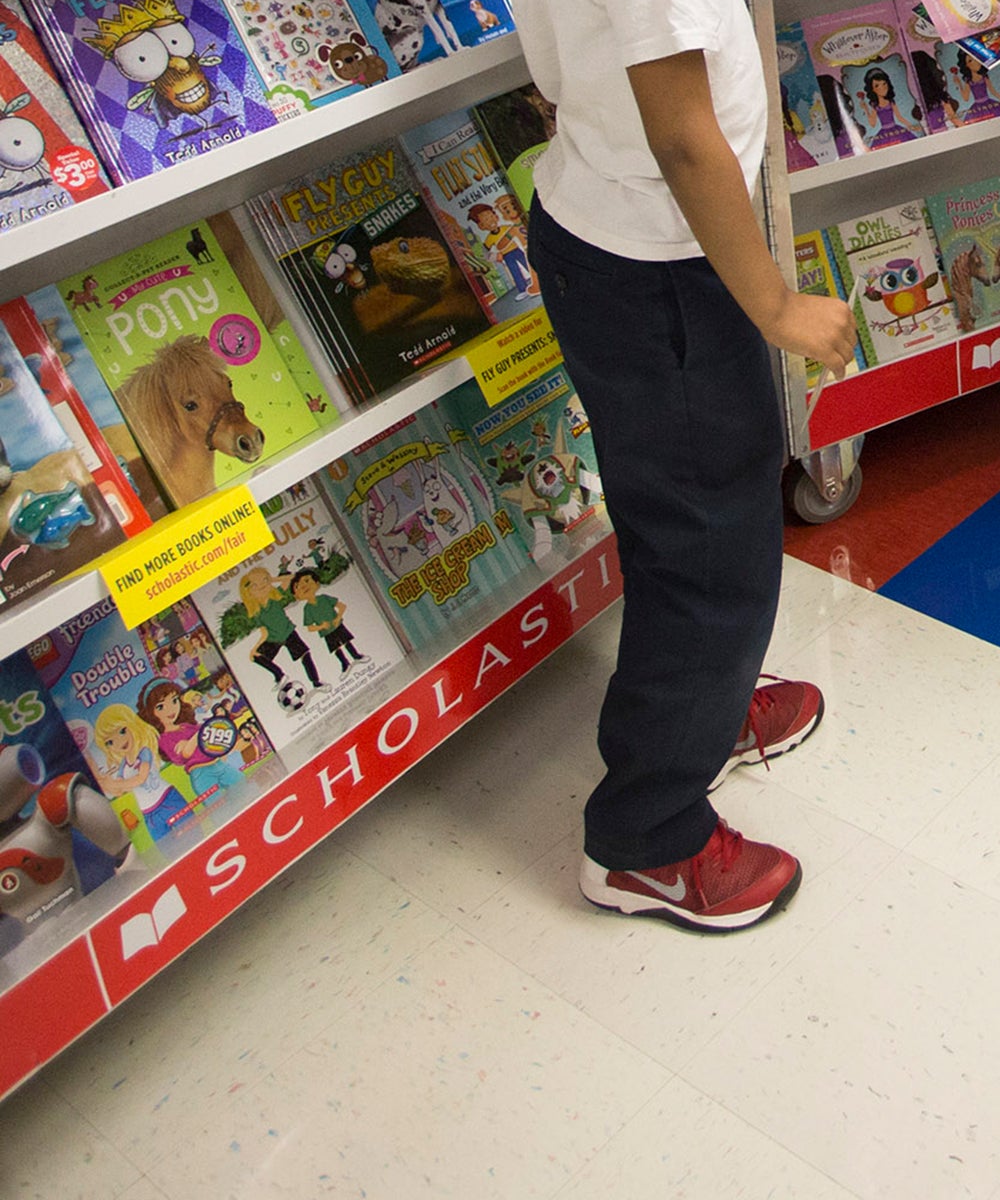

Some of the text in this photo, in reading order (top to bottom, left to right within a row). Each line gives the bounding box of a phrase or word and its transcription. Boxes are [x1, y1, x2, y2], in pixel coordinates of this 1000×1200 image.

[822, 28, 890, 56] Whatever After
[165, 127, 244, 164] Tedd Arnold
[438, 136, 459, 150] Can
[281, 148, 396, 223] FLY GUY
[430, 156, 473, 201] FLAT
[470, 191, 482, 206] the
[479, 182, 499, 197] Very
[19, 192, 70, 222] Arnold
[305, 184, 397, 236] PRESENTS
[362, 192, 417, 237] SNAKES
[945, 189, 1000, 216] Princess
[951, 209, 994, 230] Ponies
[848, 226, 903, 250] DIARIES
[856, 215, 892, 235] OWL
[398, 344, 425, 363] Tedd
[425, 324, 457, 349] Arnold
[480, 338, 549, 384] FLY GUY PRESENTS:
[474, 412, 506, 437] NOW
[501, 398, 528, 417] YOU
[525, 385, 548, 404] SEE
[332, 461, 343, 477] 1
[115, 566, 145, 594] FIND
[143, 546, 179, 576] MORE
[175, 526, 215, 557] BOOKS
[213, 500, 257, 534] ONLINE!
[145, 529, 247, 601] scholastic.com/fair
[391, 573, 423, 606] THE
[418, 553, 447, 584] ICE
[442, 526, 495, 572] CREAM
[25, 568, 57, 589] Emerson
[217, 566, 241, 586] AND
[433, 562, 470, 603] SHOP
[70, 643, 136, 691] Double
[76, 657, 148, 708] Trouble
[204, 552, 612, 897] SCHOLASTI
[303, 702, 322, 717] Tony
